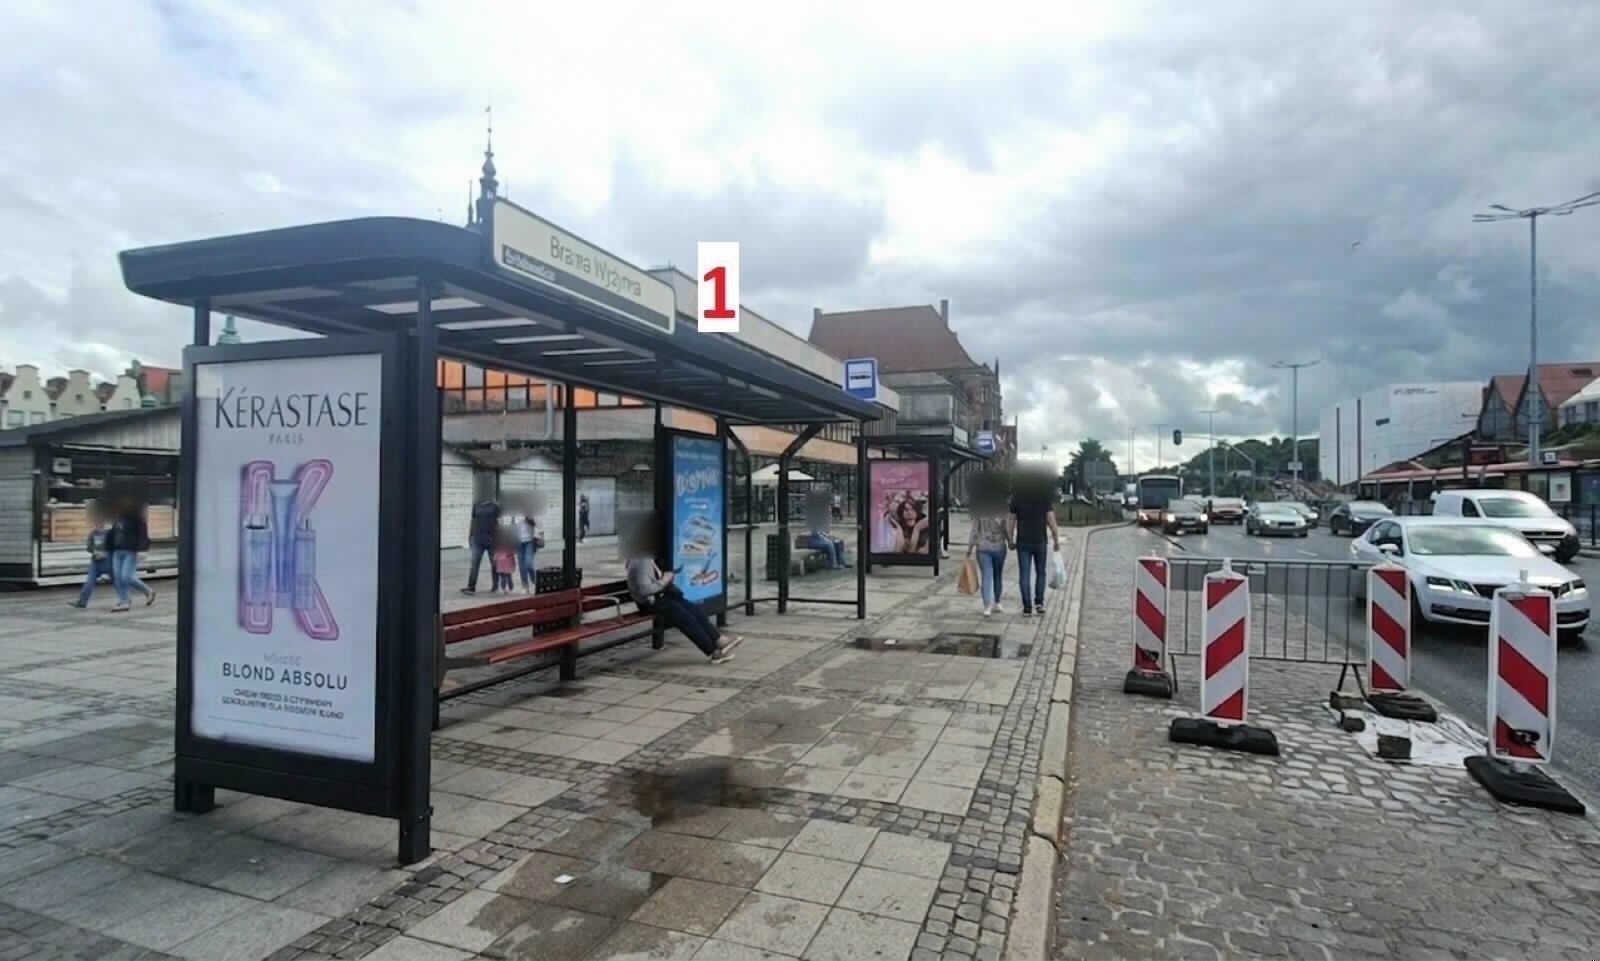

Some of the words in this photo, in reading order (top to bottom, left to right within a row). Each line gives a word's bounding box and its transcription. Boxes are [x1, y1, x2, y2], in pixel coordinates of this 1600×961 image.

[215, 386, 368, 429] KÉRASTASE
[223, 662, 275, 681] BLOND
[280, 668, 347, 690] ABSOLU
